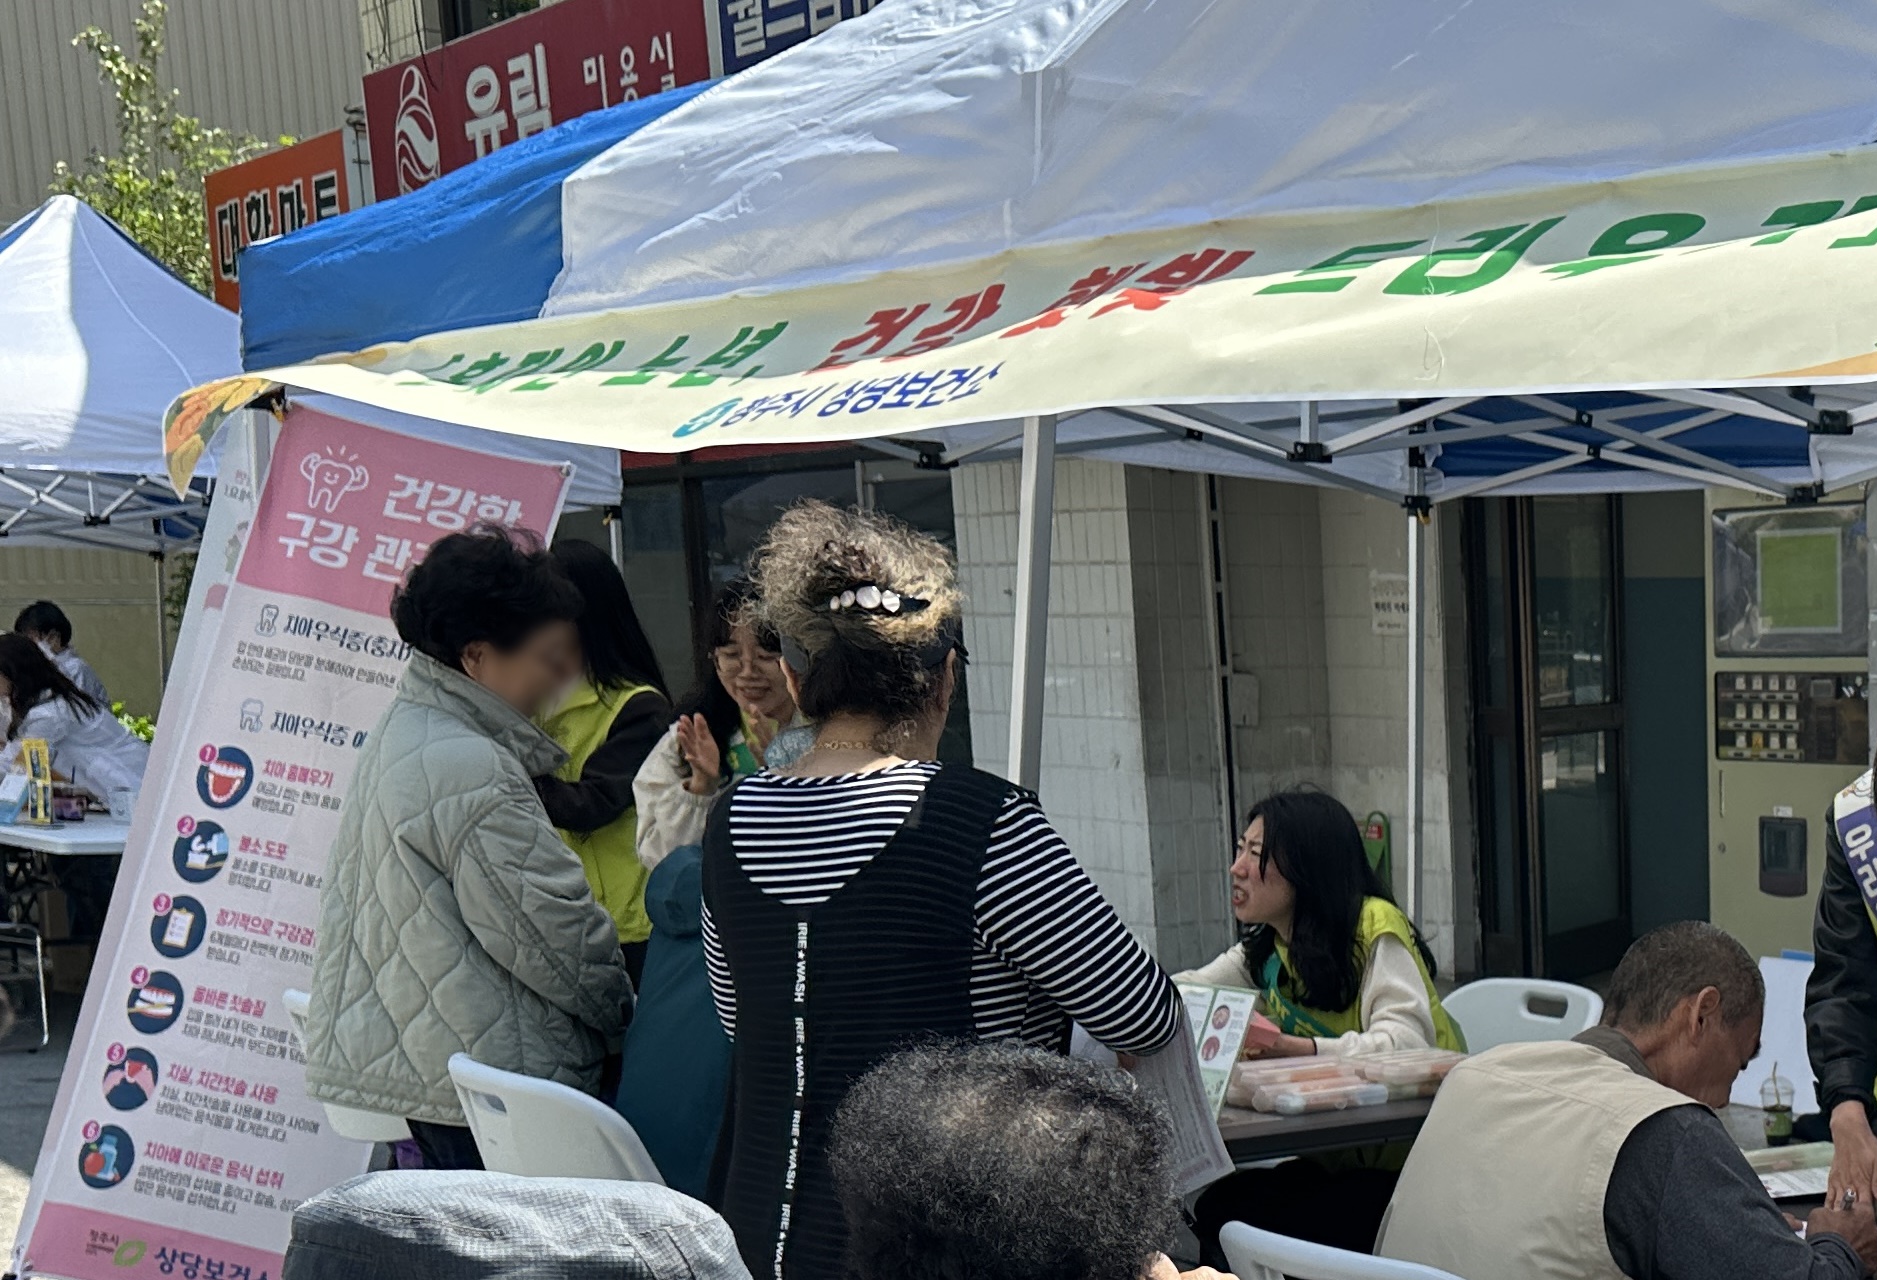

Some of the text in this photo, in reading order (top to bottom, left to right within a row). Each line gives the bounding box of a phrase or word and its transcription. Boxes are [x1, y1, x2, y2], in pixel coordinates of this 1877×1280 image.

[465, 43, 552, 159] 유림
[804, 283, 1006, 376] 건강
[816, 361, 1006, 419] 상당보건소
[383, 473, 524, 534] 건강한
[279, 512, 426, 583] 구강 관
[272, 920, 320, 948] 구강검
